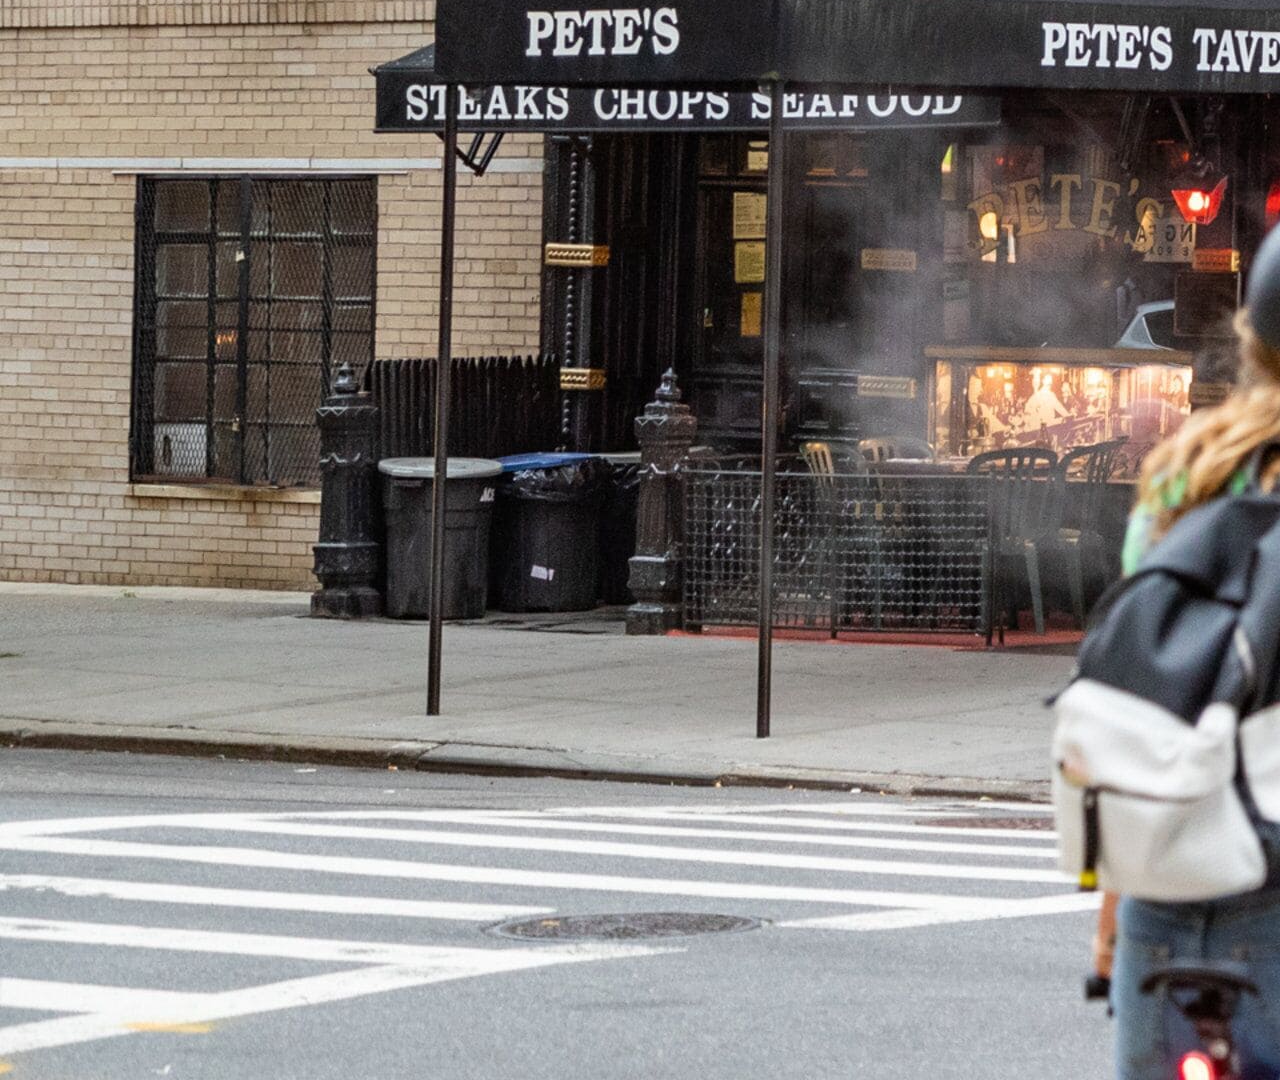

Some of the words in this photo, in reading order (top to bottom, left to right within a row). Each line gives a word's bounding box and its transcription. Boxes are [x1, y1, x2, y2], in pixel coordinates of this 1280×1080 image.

[525, 7, 681, 57] PETE'S
[1041, 22, 1173, 71] PETE'S
[405, 84, 570, 121] STEAKS
[593, 88, 730, 120] CHOPS
[967, 174, 1165, 255] PETE'S
